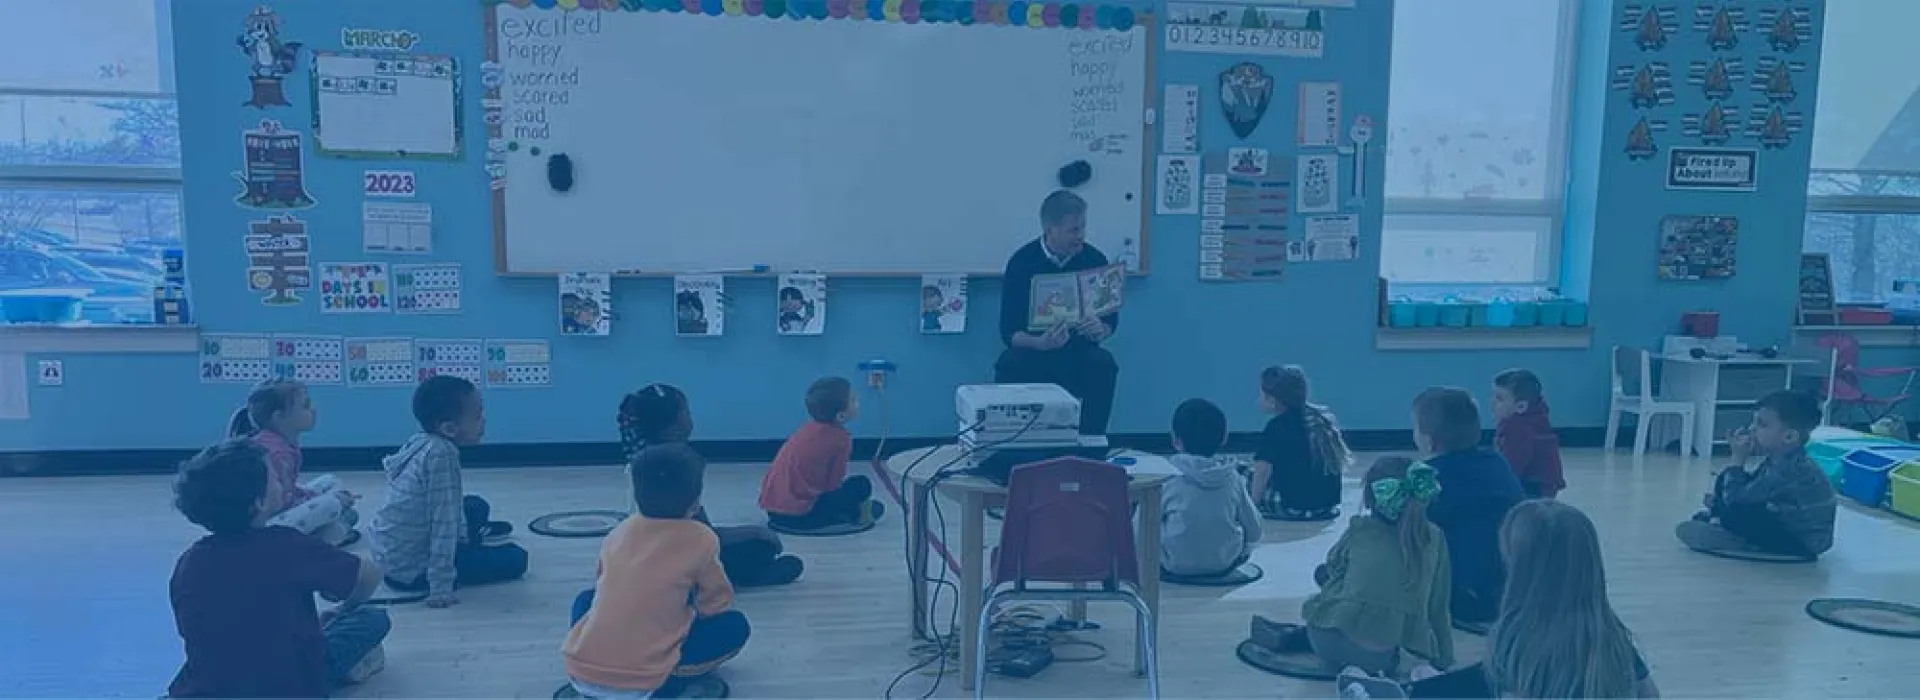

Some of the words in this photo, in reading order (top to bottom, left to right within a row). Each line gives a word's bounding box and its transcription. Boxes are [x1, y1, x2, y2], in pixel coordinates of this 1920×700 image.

[501, 11, 600, 38] excited
[1169, 26, 1181, 43] 0
[1185, 26, 1189, 43] 1
[1193, 27, 1203, 44] 2
[1210, 27, 1220, 44] 3
[1221, 27, 1231, 45] 4
[1236, 29, 1246, 46] 5
[1250, 30, 1260, 46] 6
[1263, 28, 1273, 46] 7
[1276, 31, 1286, 48] 8
[1290, 31, 1301, 48] 9
[1304, 33, 1320, 49] 10
[507, 39, 563, 66] happy
[508, 66, 579, 86] worried
[512, 88, 569, 105] scared
[513, 106, 546, 123] sad
[514, 123, 550, 139] mad
[1677, 168, 1712, 178] About
[365, 173, 413, 193] 2023
[322, 280, 362, 293] DAYS
[324, 295, 389, 308] SCHOOL
[204, 342, 219, 356] 10
[203, 363, 222, 379] 20
[275, 363, 295, 379] 40
[349, 367, 369, 382] 60
